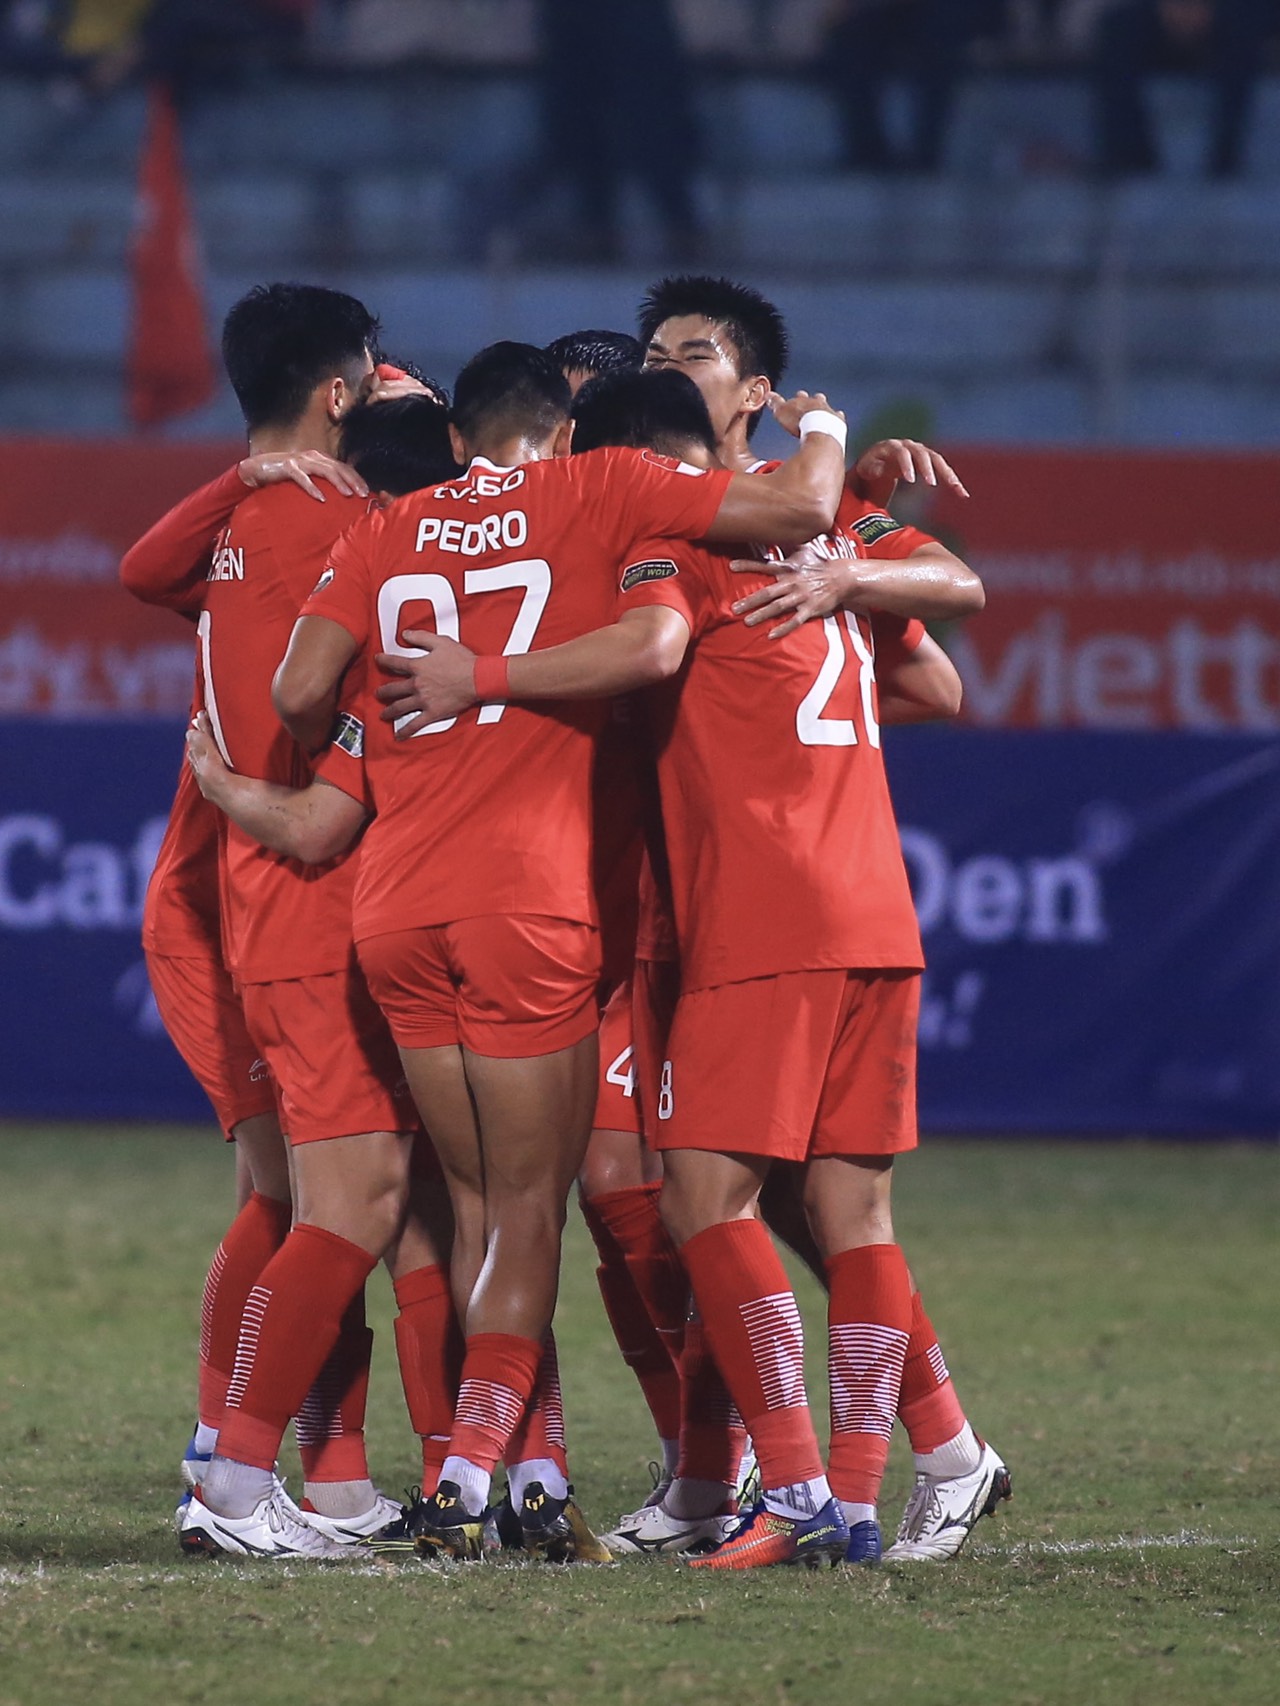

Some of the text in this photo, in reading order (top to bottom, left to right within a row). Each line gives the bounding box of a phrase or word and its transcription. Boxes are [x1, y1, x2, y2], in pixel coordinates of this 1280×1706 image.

[416, 510, 528, 556] PEDRO
[378, 558, 552, 738] 97
[658, 1060, 674, 1120] 8
[796, 1524, 837, 1546] MERCURIAL
